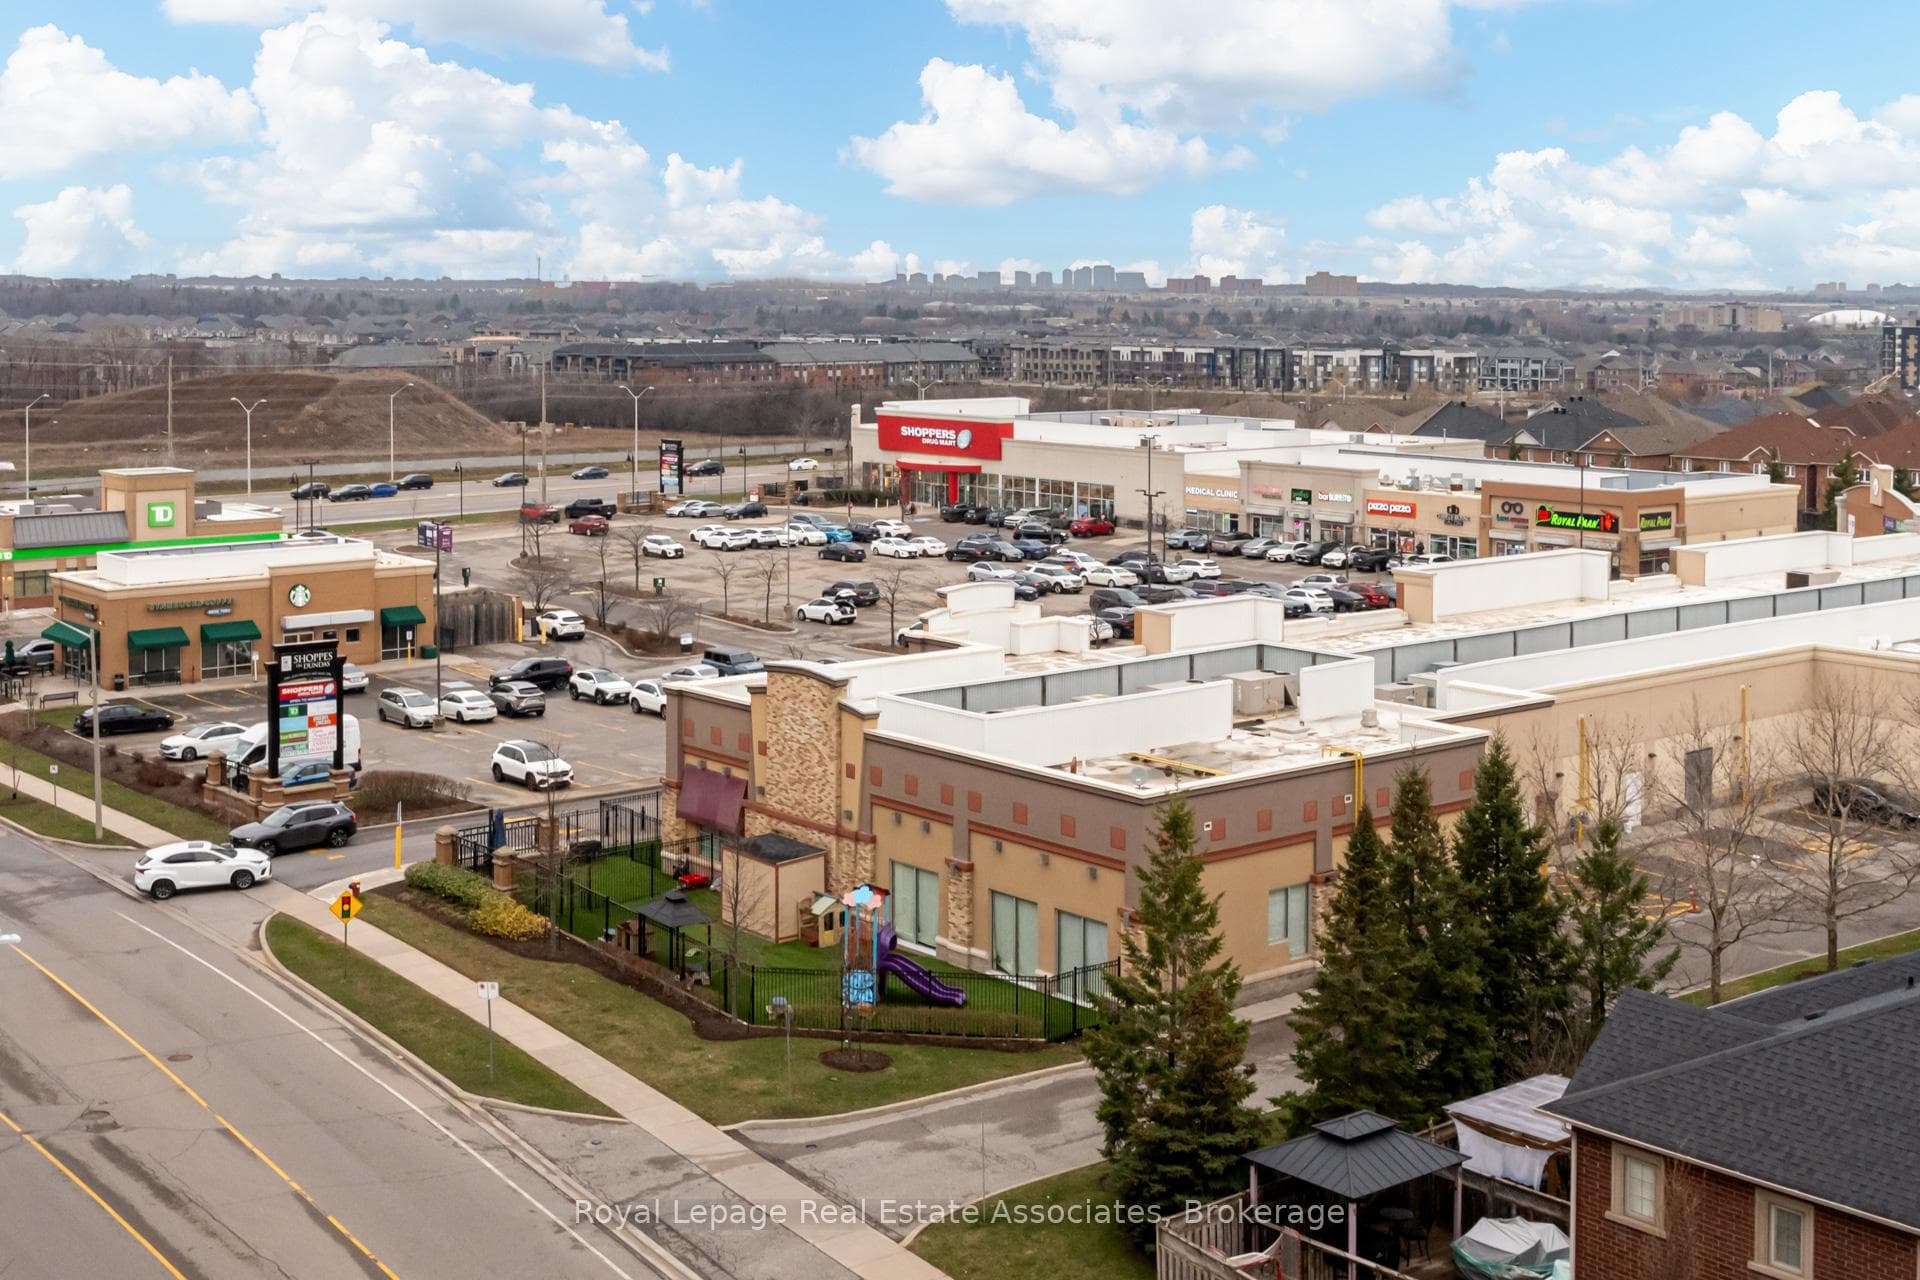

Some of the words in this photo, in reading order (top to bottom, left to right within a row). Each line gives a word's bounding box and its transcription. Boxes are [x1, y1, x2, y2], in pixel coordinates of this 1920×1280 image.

[901, 426, 956, 440] SHOPPERS
[1185, 486, 1215, 496] MEDICAL
[1216, 489, 1238, 498] CLINIC
[151, 506, 173, 522] TD
[1368, 502, 1388, 512] pizza
[1390, 504, 1411, 514] pizza
[293, 651, 333, 664] SHOPPES
[303, 661, 330, 669] DUNDAS
